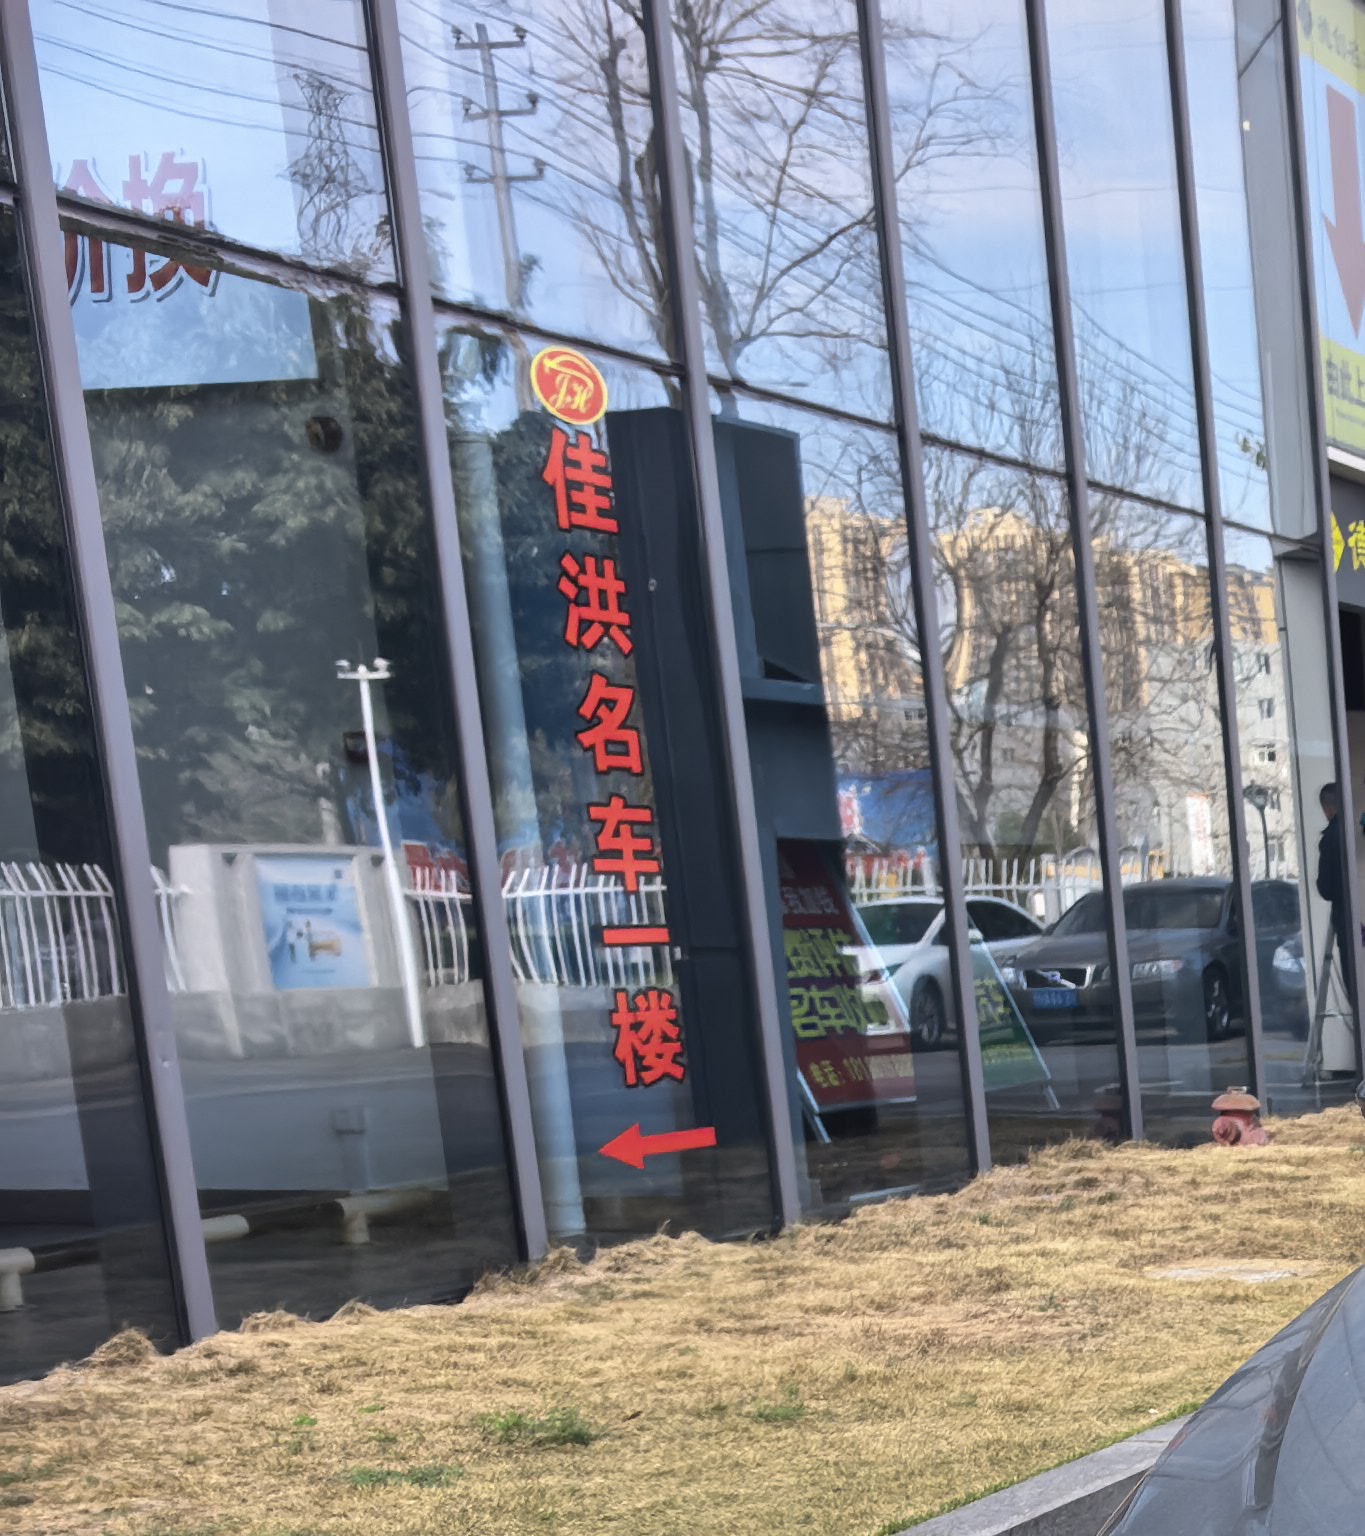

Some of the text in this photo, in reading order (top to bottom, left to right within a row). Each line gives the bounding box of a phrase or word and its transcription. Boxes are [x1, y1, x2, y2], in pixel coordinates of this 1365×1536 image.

[541, 427, 685, 1087] 佳洪名车一楼
